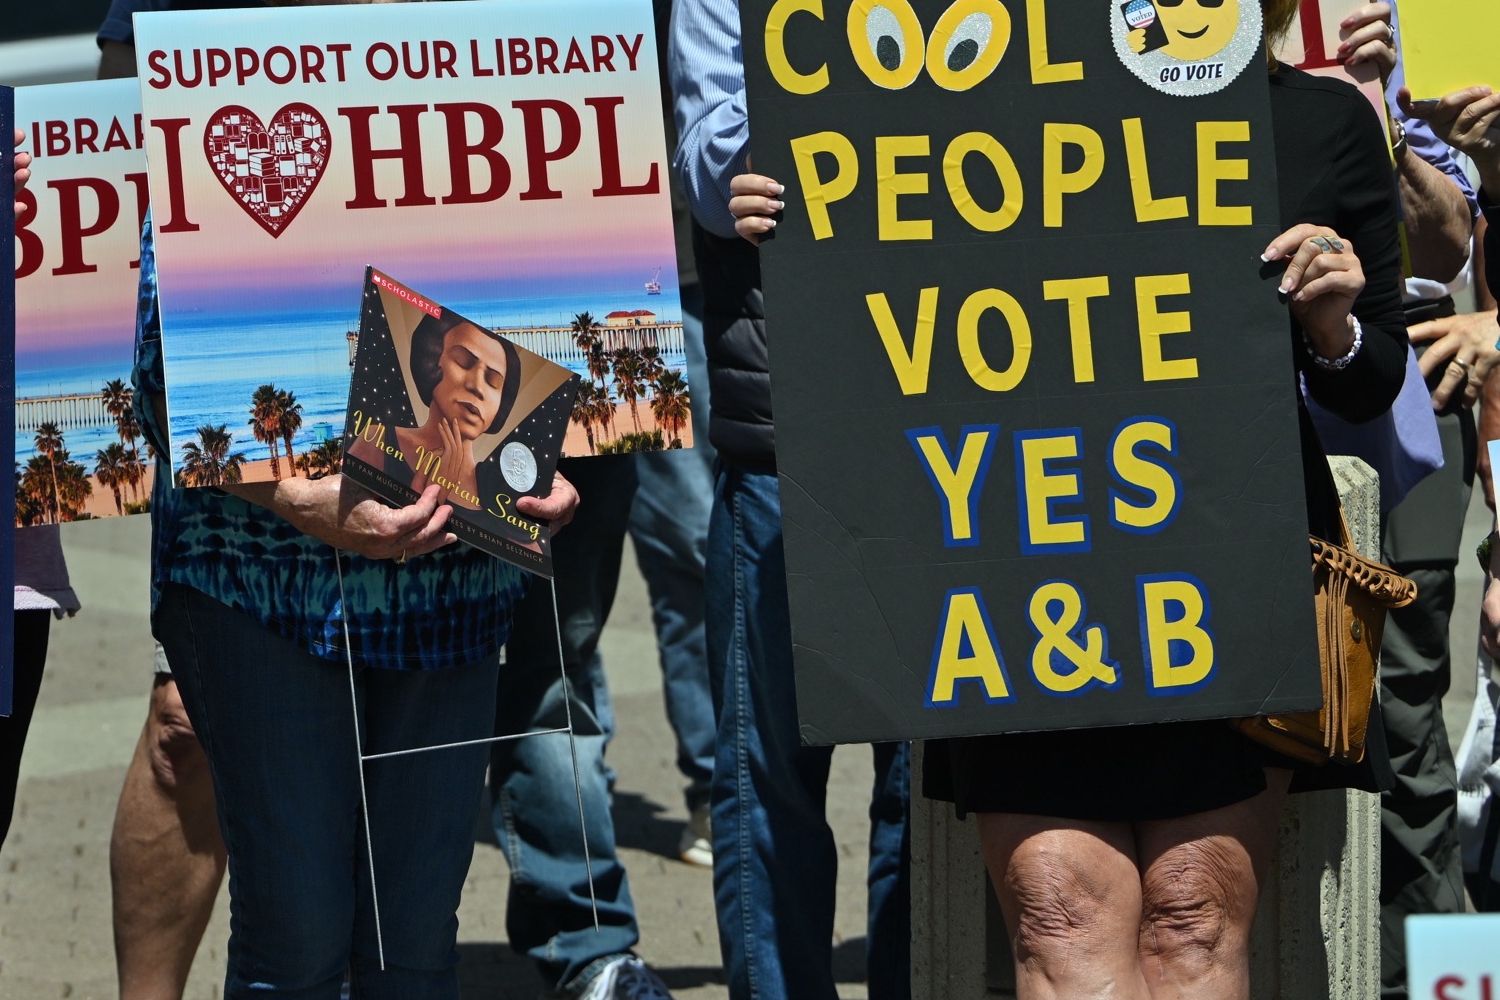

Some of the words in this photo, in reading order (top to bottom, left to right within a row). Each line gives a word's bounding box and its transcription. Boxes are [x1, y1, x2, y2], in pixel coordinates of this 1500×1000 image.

[1131, 11, 1153, 23] VOTED
[147, 43, 352, 89] SUPPORT
[366, 40, 457, 80] OUR
[471, 34, 644, 77] LIBRARY
[1160, 66, 1180, 83] GO
[1186, 63, 1224, 81] VOTE
[15, 114, 145, 158] IBRA
[150, 117, 200, 233] I
[337, 96, 661, 210] HBPL
[790, 117, 1253, 242] PEOPLE
[381, 279, 441, 317] SCHOLASTIC
[865, 272, 1200, 396] VOTE
[353, 411, 405, 463] When
[414, 445, 481, 507] Marian
[487, 492, 541, 541] Sang
[904, 415, 1184, 556] YES
[479, 531, 503, 547] BRIAN
[505, 542, 544, 564] SELZNICK
